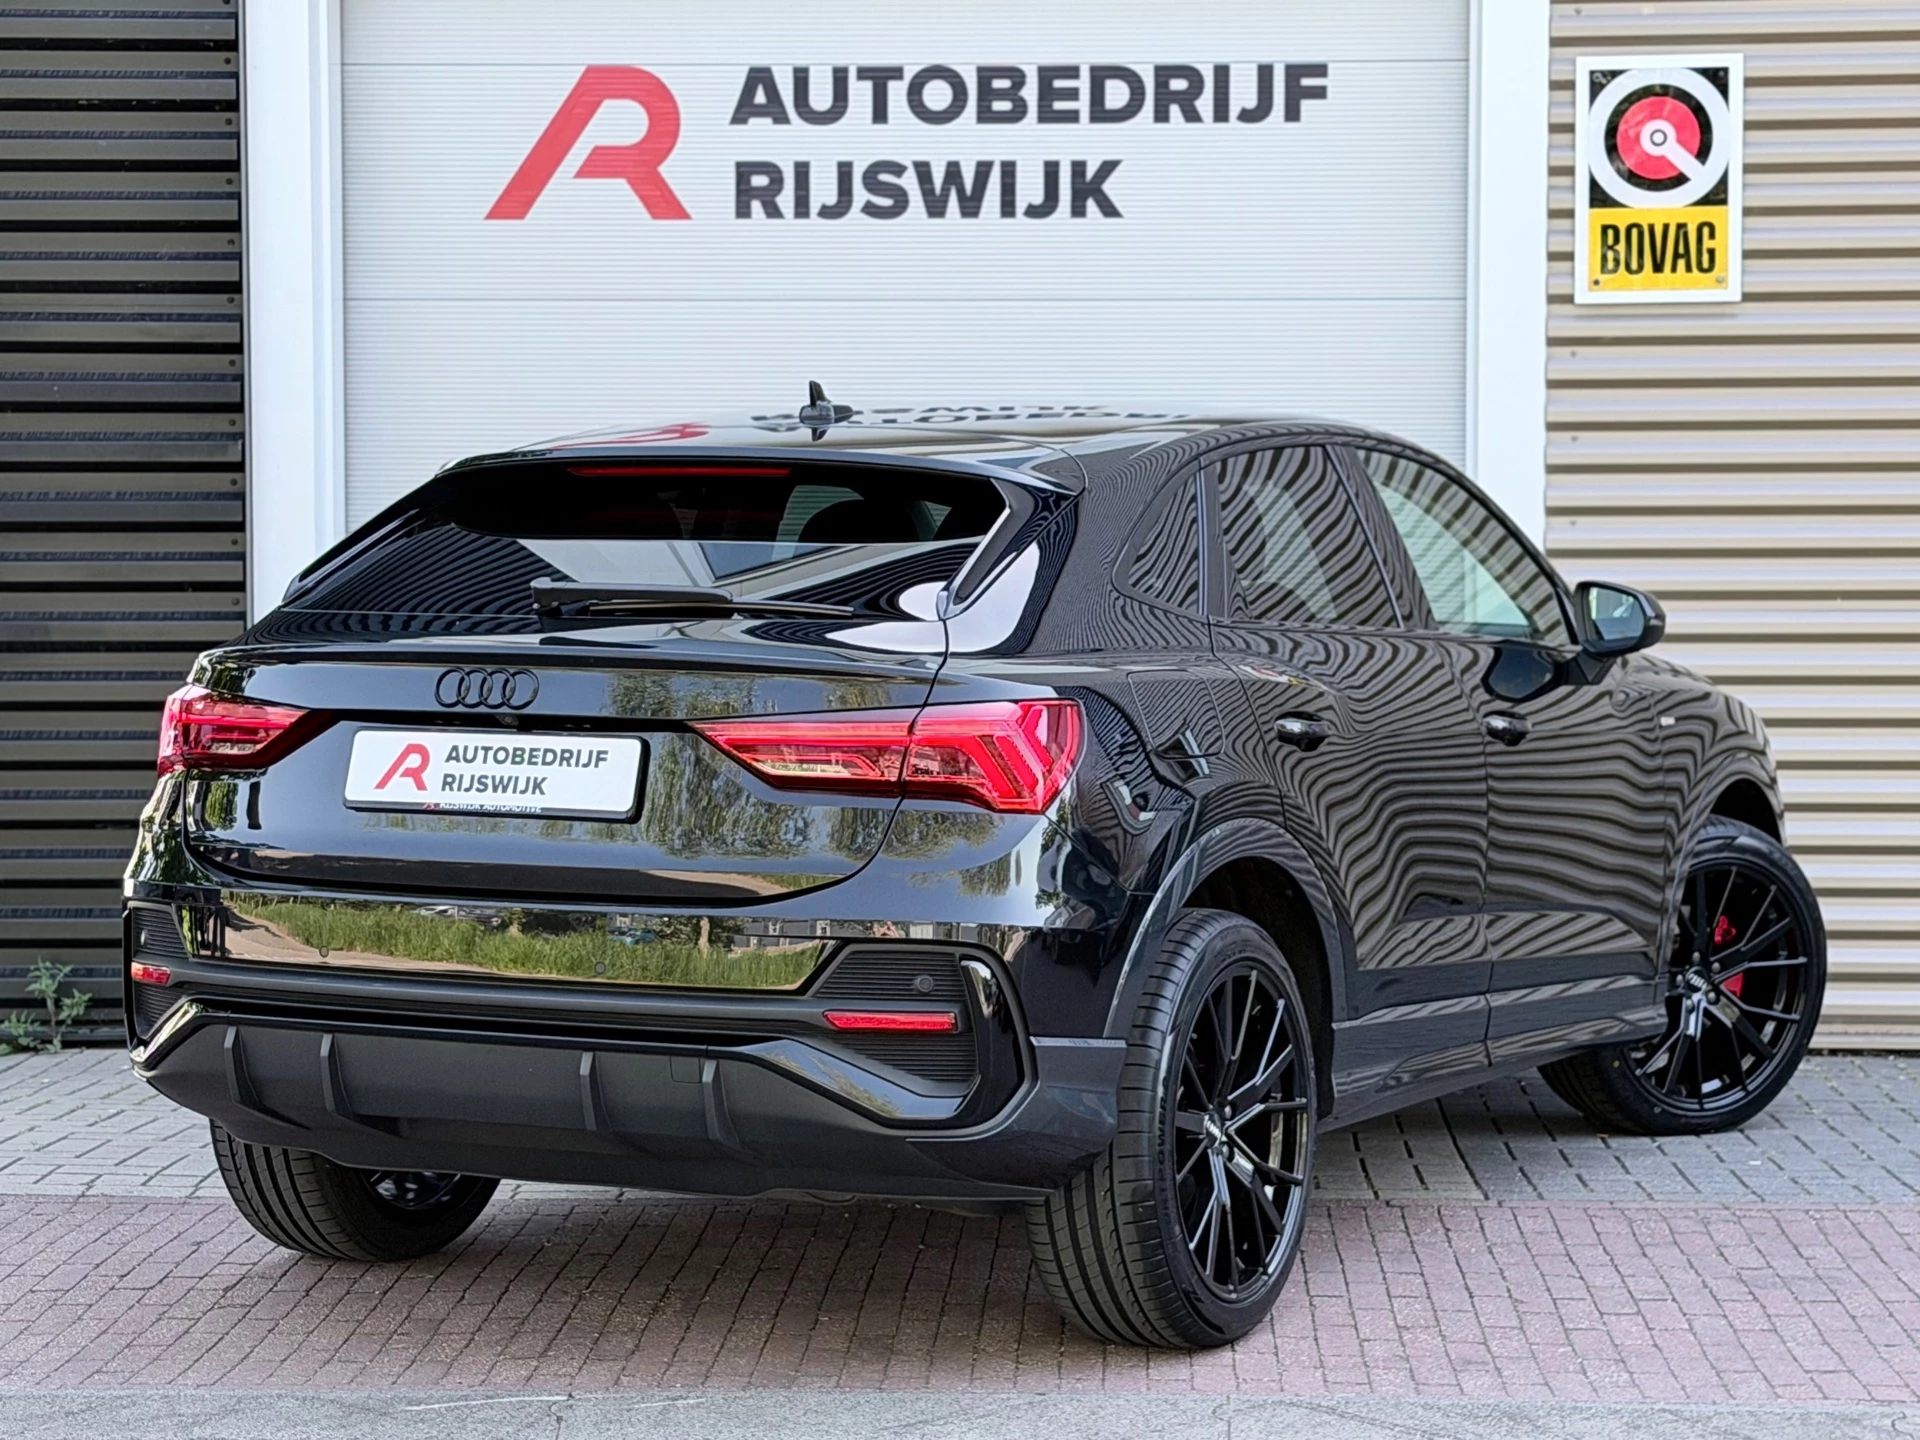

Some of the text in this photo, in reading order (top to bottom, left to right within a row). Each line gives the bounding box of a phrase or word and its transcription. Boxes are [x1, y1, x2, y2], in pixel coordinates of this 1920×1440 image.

[729, 63, 1328, 125] AUTOBEDRIJF
[735, 159, 1123, 220] RIJSWIJK
[1600, 220, 1716, 275] BOVAG
[444, 744, 609, 769] AUTOBEDRIJF
[441, 773, 548, 796] RIJSWIJK
